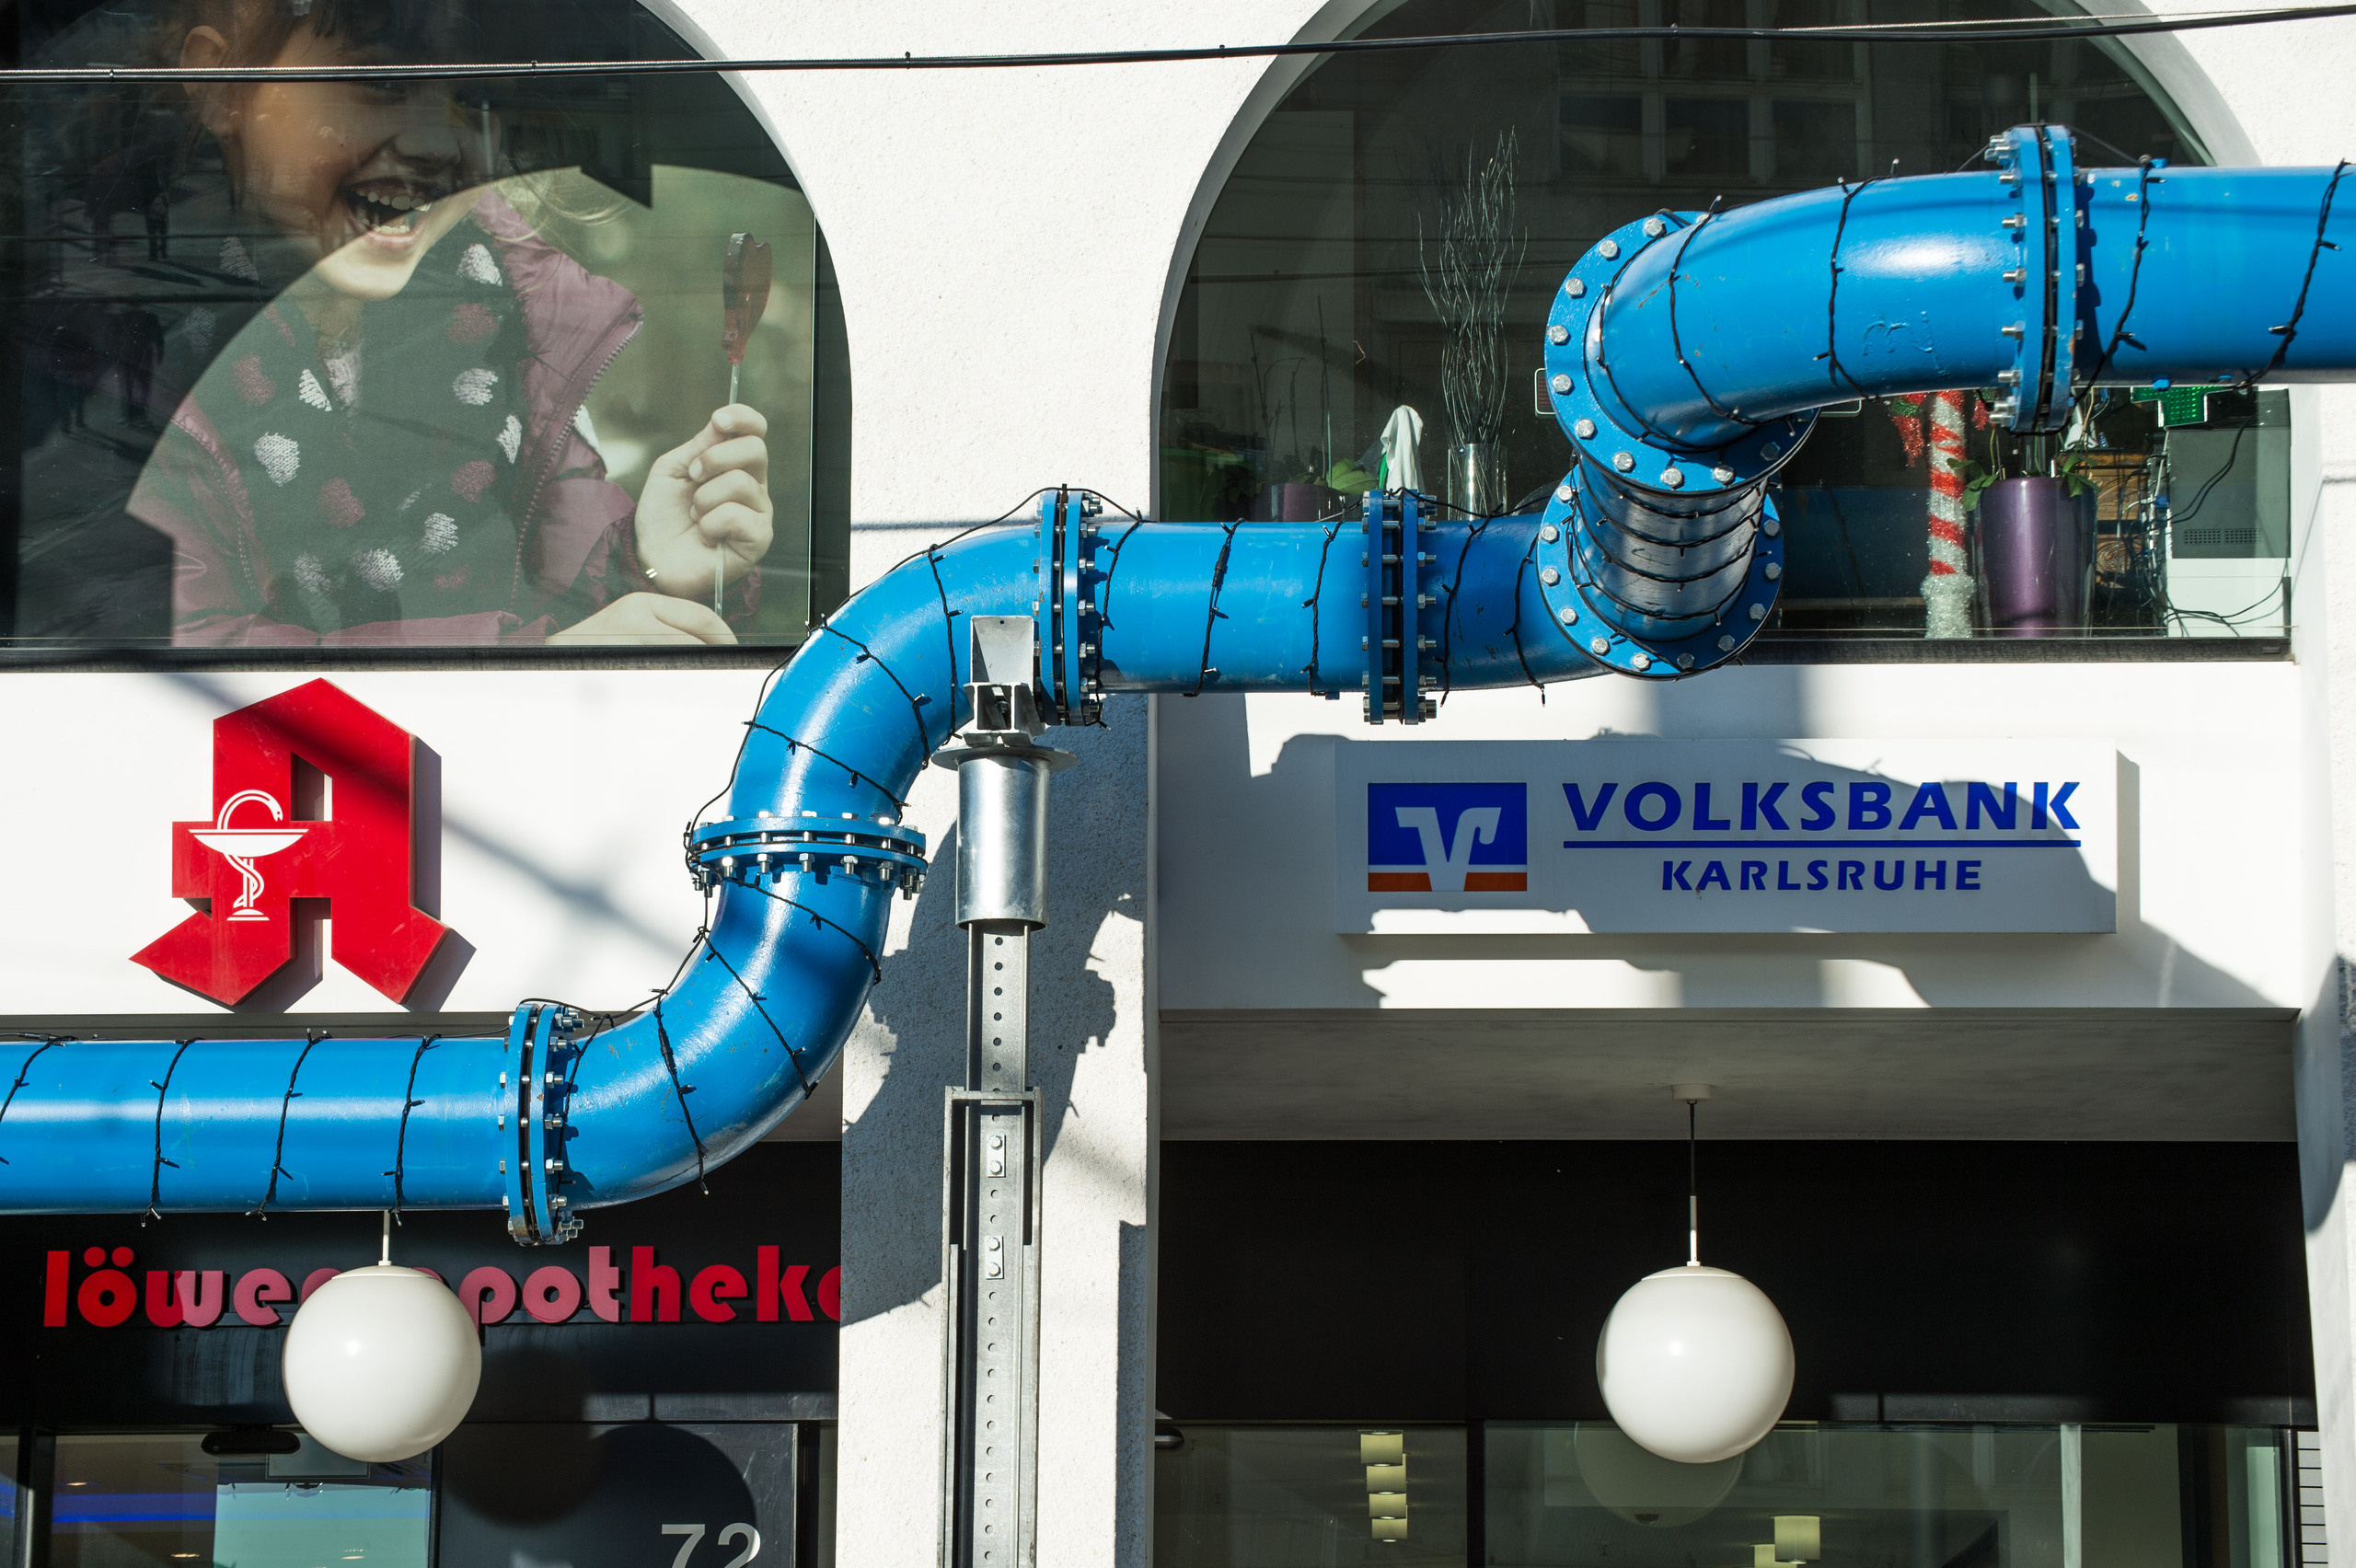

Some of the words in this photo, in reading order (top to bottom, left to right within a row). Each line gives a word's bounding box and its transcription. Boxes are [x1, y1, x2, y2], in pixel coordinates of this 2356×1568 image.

[1562, 780, 2081, 832] VOLKSBANK
[1661, 859, 1981, 892] KARLSRUHE
[412, 1245, 841, 1335] pothek
[661, 1522, 761, 1568] 72
